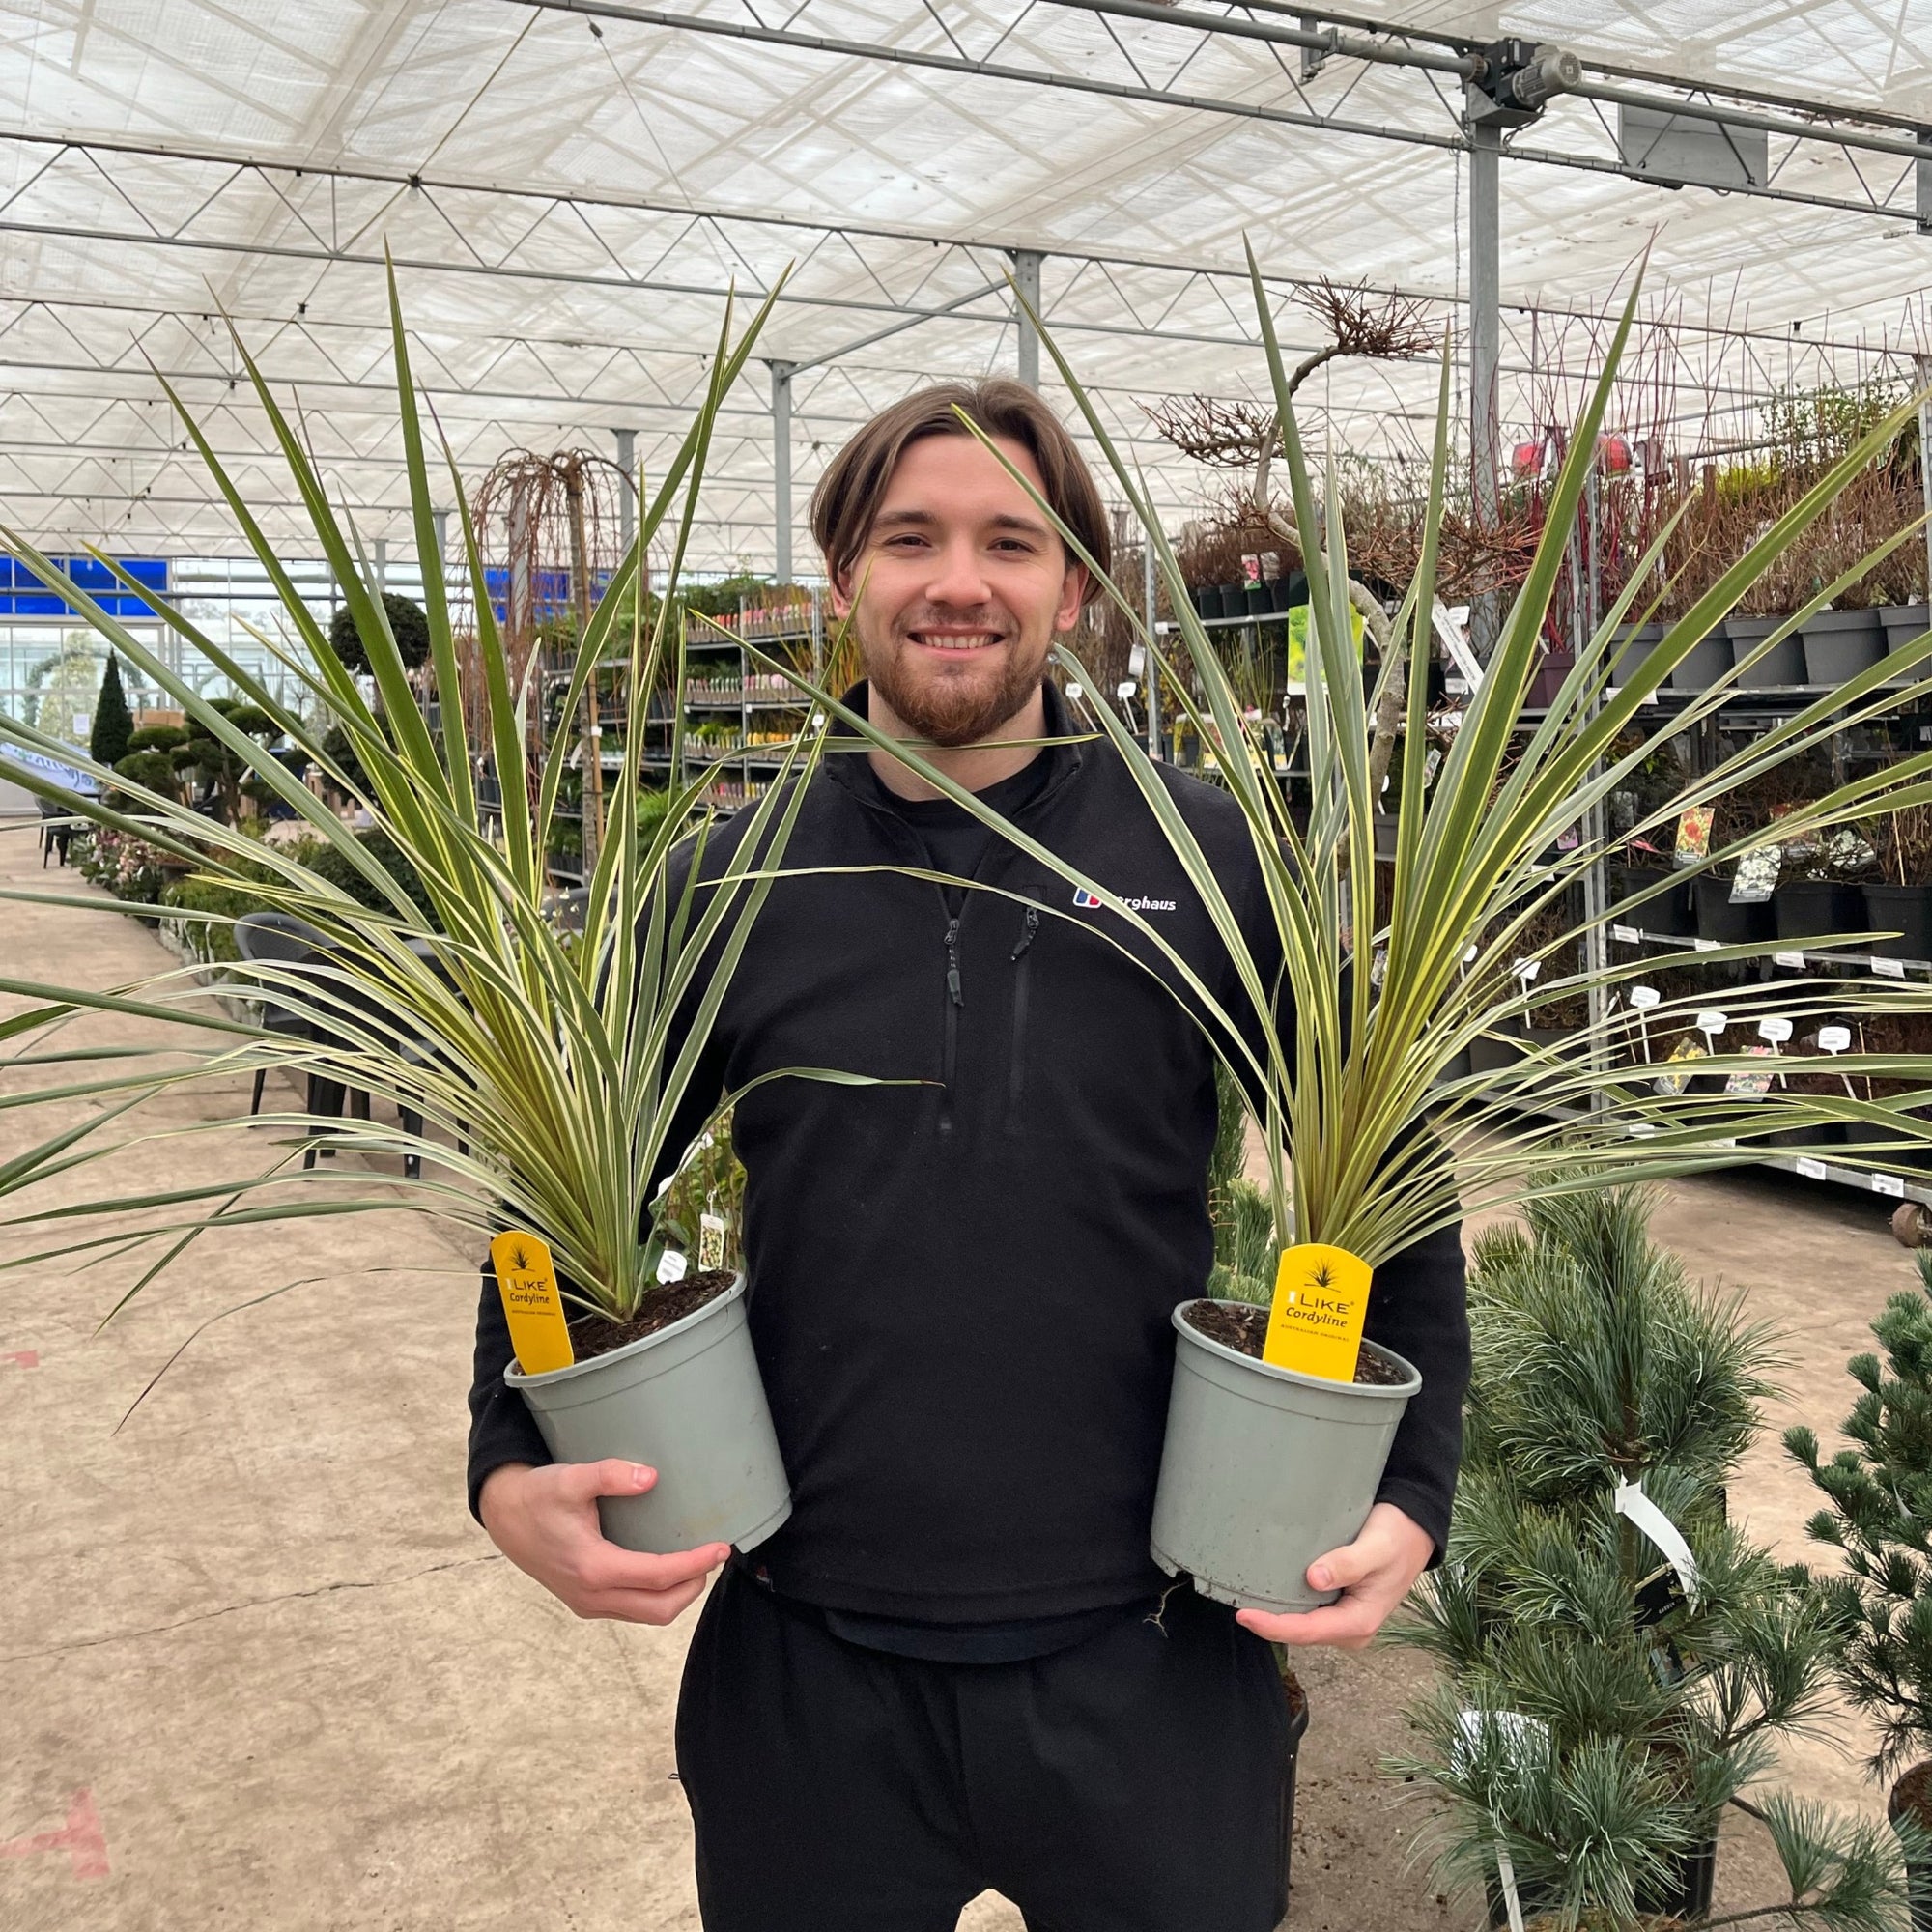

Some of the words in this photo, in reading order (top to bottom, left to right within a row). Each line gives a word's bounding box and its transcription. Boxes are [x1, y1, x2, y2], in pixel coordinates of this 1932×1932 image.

[1117, 895, 1177, 911] erghaus
[510, 1293, 550, 1306] Cordyline
[1300, 1293, 1350, 1315] LIKE
[1286, 1306, 1348, 1328] Cordyline
